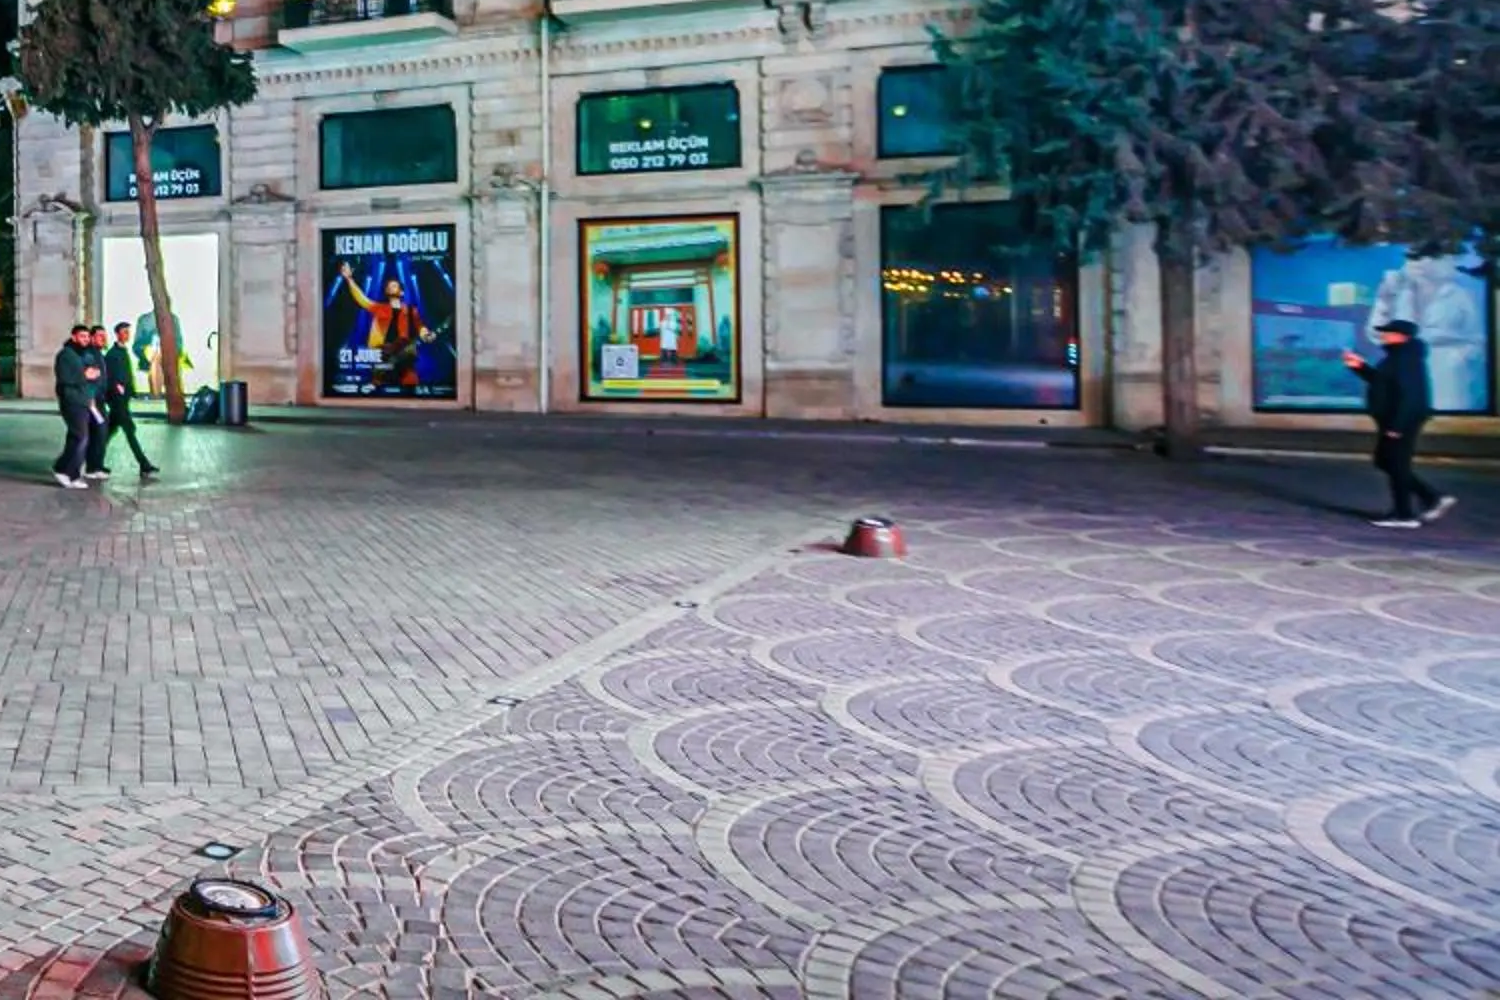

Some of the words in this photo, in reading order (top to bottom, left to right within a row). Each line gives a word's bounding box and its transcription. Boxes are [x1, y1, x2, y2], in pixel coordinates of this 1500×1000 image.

[610, 157, 639, 170] 050
[689, 152, 709, 165] 03
[129, 171, 169, 183] RAM
[185, 183, 199, 195] 03
[335, 234, 384, 255] KENAN
[387, 228, 447, 253] DOĞULU
[340, 348, 352, 362] 21
[355, 347, 383, 362] JUNE
